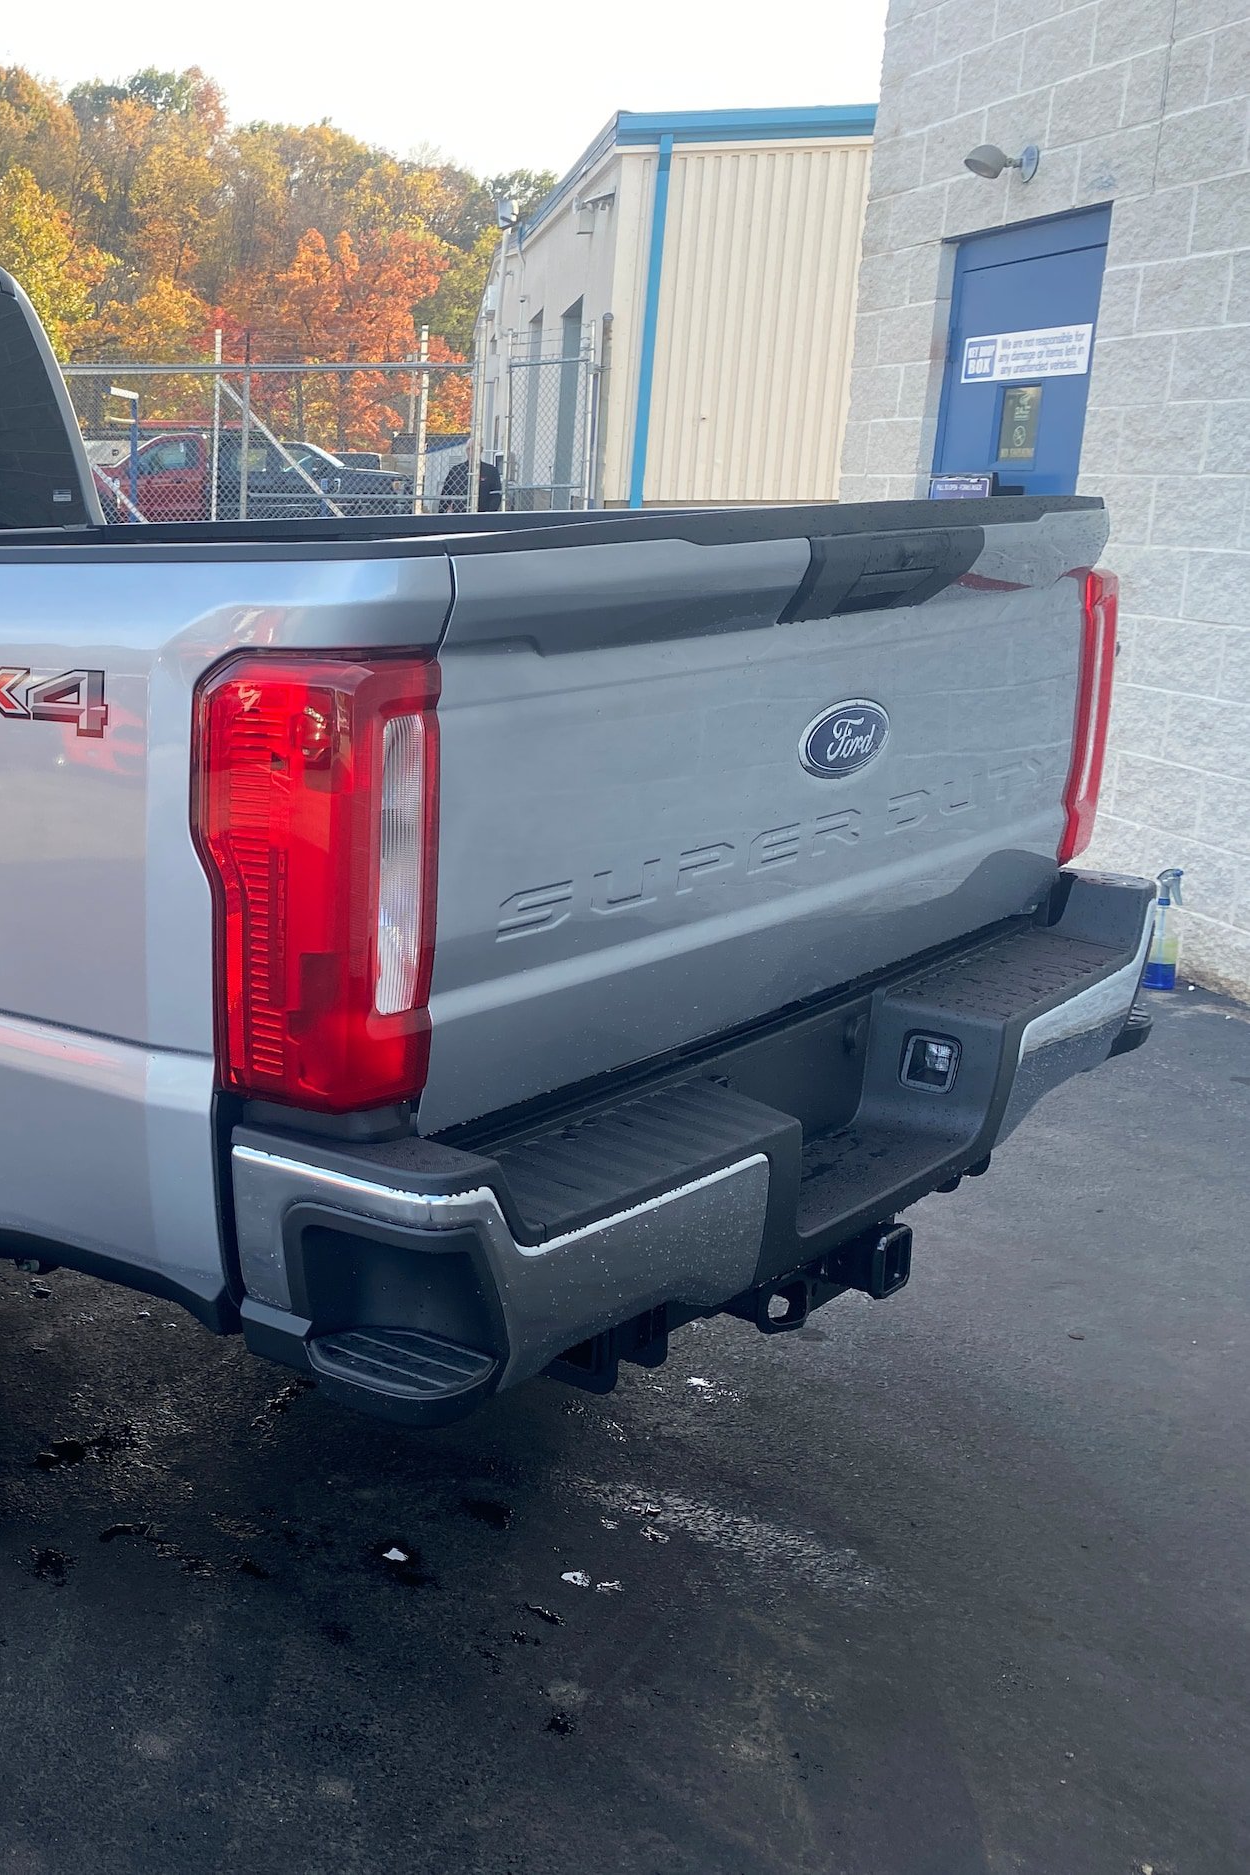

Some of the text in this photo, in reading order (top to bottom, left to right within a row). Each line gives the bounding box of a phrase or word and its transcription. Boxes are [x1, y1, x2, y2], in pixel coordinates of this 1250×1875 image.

[1001, 338, 1012, 349] We
[1013, 340, 1023, 349] are
[1024, 338, 1035, 347] not
[1075, 330, 1085, 342] for
[968, 358, 990, 374] BOX
[826, 716, 876, 762] Ford
[884, 754, 1057, 835] DUTY
[495, 807, 862, 943] SUPER
